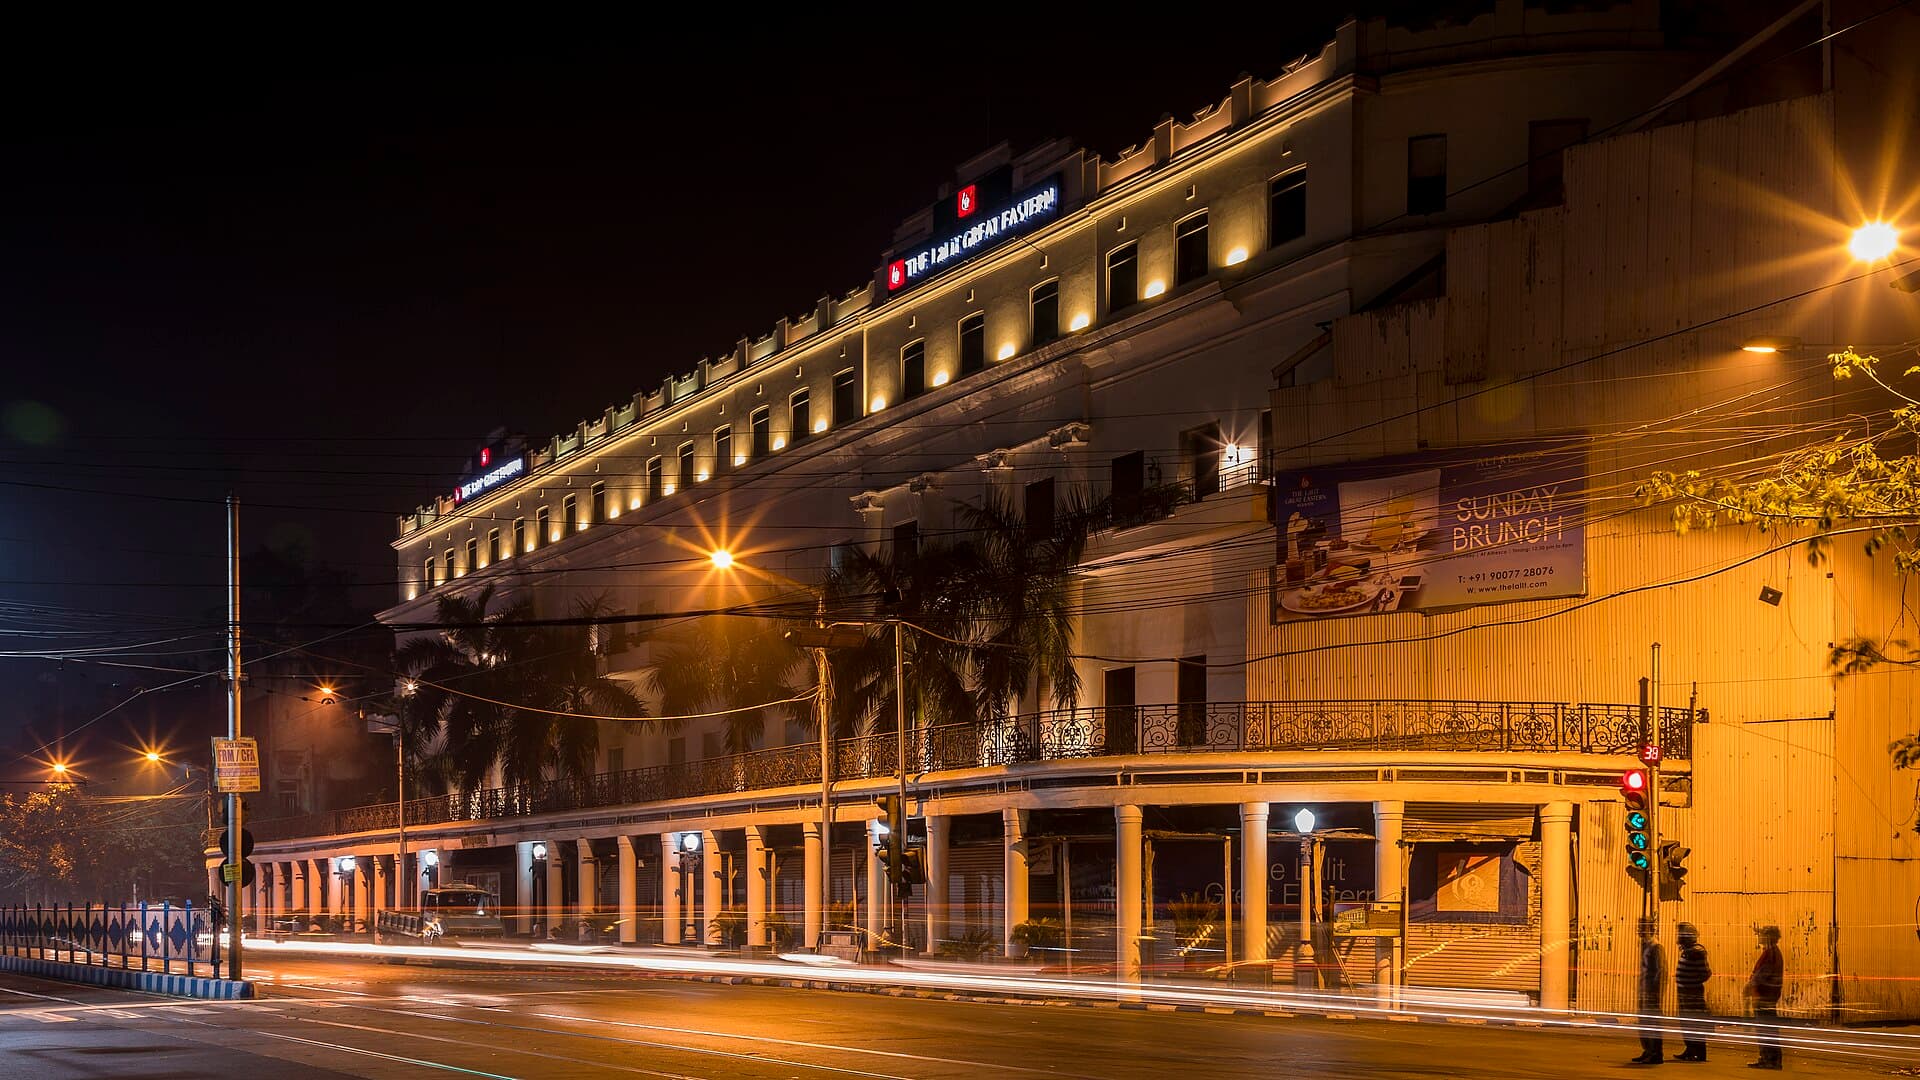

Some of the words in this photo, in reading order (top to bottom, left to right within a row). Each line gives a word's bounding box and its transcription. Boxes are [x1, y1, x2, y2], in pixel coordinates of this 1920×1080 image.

[962, 216, 1000, 249] GREAT
[1001, 187, 1055, 230] EASTERN
[1456, 486, 1559, 521] SUNDAY
[1453, 515, 1562, 552] BRUNCH
[1458, 575, 1466, 583] T:
[1469, 573, 1486, 582] +91
[1490, 569, 1520, 580] 90077
[1523, 566, 1554, 577] 28076
[1644, 746, 1659, 760] 38
[1295, 857, 1346, 881] Llit
